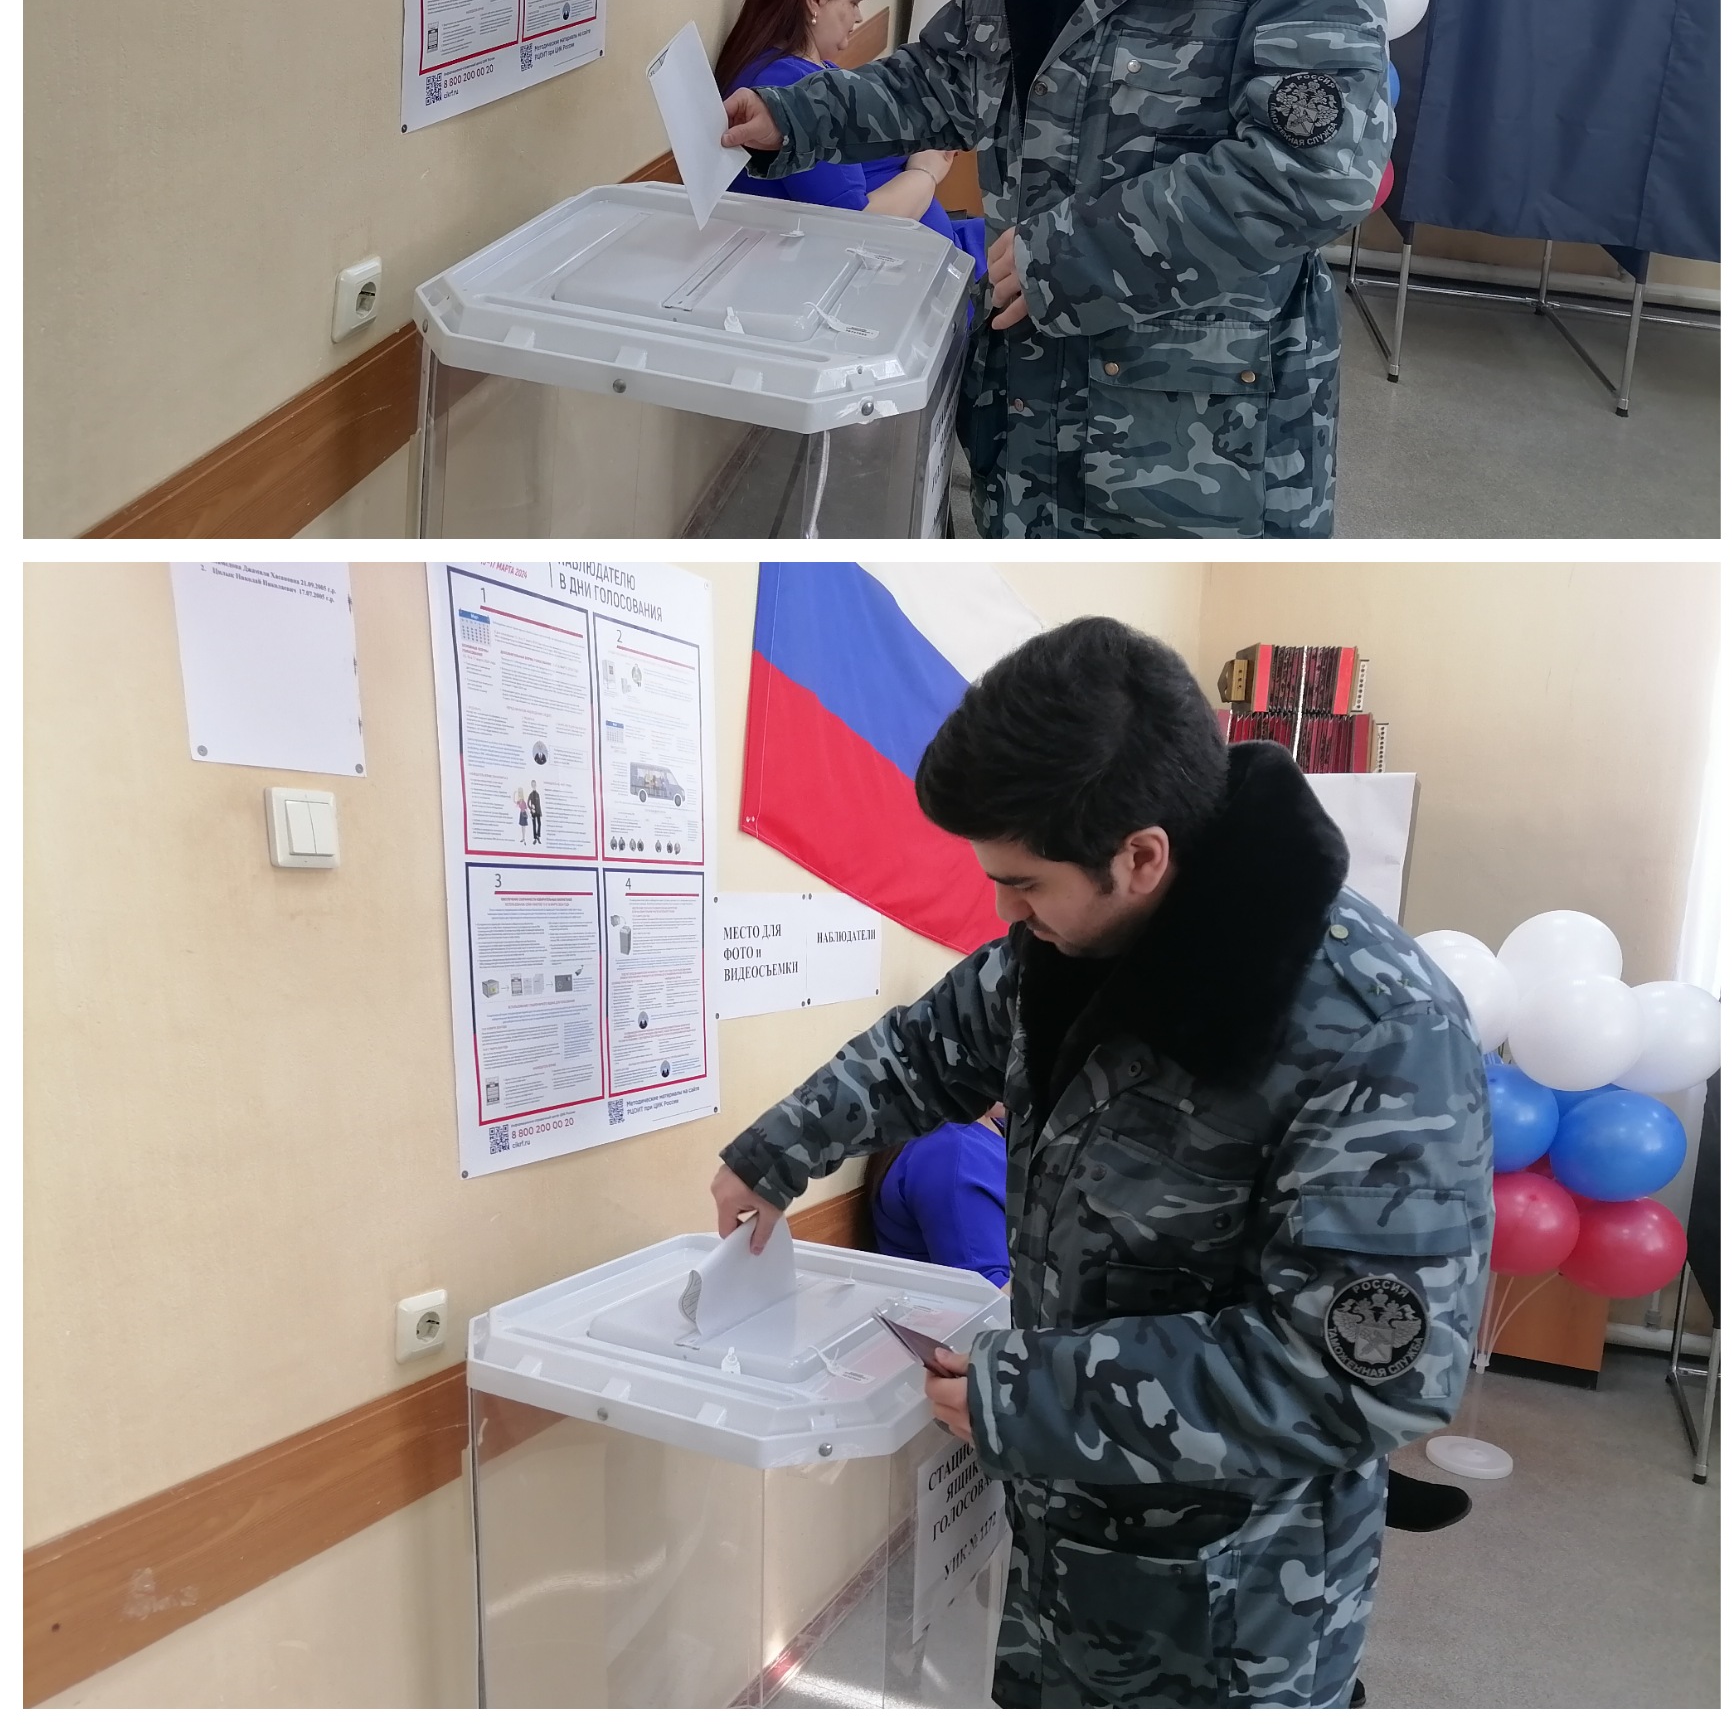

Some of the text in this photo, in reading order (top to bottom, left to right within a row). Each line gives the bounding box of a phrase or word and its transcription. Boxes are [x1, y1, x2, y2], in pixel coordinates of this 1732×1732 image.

[1297, 74, 1335, 88] РОССИЯ
[1307, 123, 1337, 145] СЛУЖБА
[496, 563, 527, 579] МАРТА 2024
[480, 588, 486, 603] 1
[560, 573, 662, 622] В ДНИ ГОЛОСОВАНИЯ
[616, 630, 622, 642] 2
[494, 874, 502, 888] 3
[625, 878, 631, 890] 4
[723, 924, 782, 940] МЕСТО ДЛЯ
[817, 929, 876, 943] НАБЛЮДАТЕЛИ
[724, 946, 761, 960] ФОТО и
[724, 961, 798, 982] ВИДЕОСЪЕМКИ
[1352, 1280, 1409, 1297] РОССИЯ
[1328, 1328, 1424, 1377] ТАМОЖЕННАЯ СЛУЖБА
[946, 1460, 978, 1503] ЯЩИК
[944, 1544, 967, 1580] УИК
